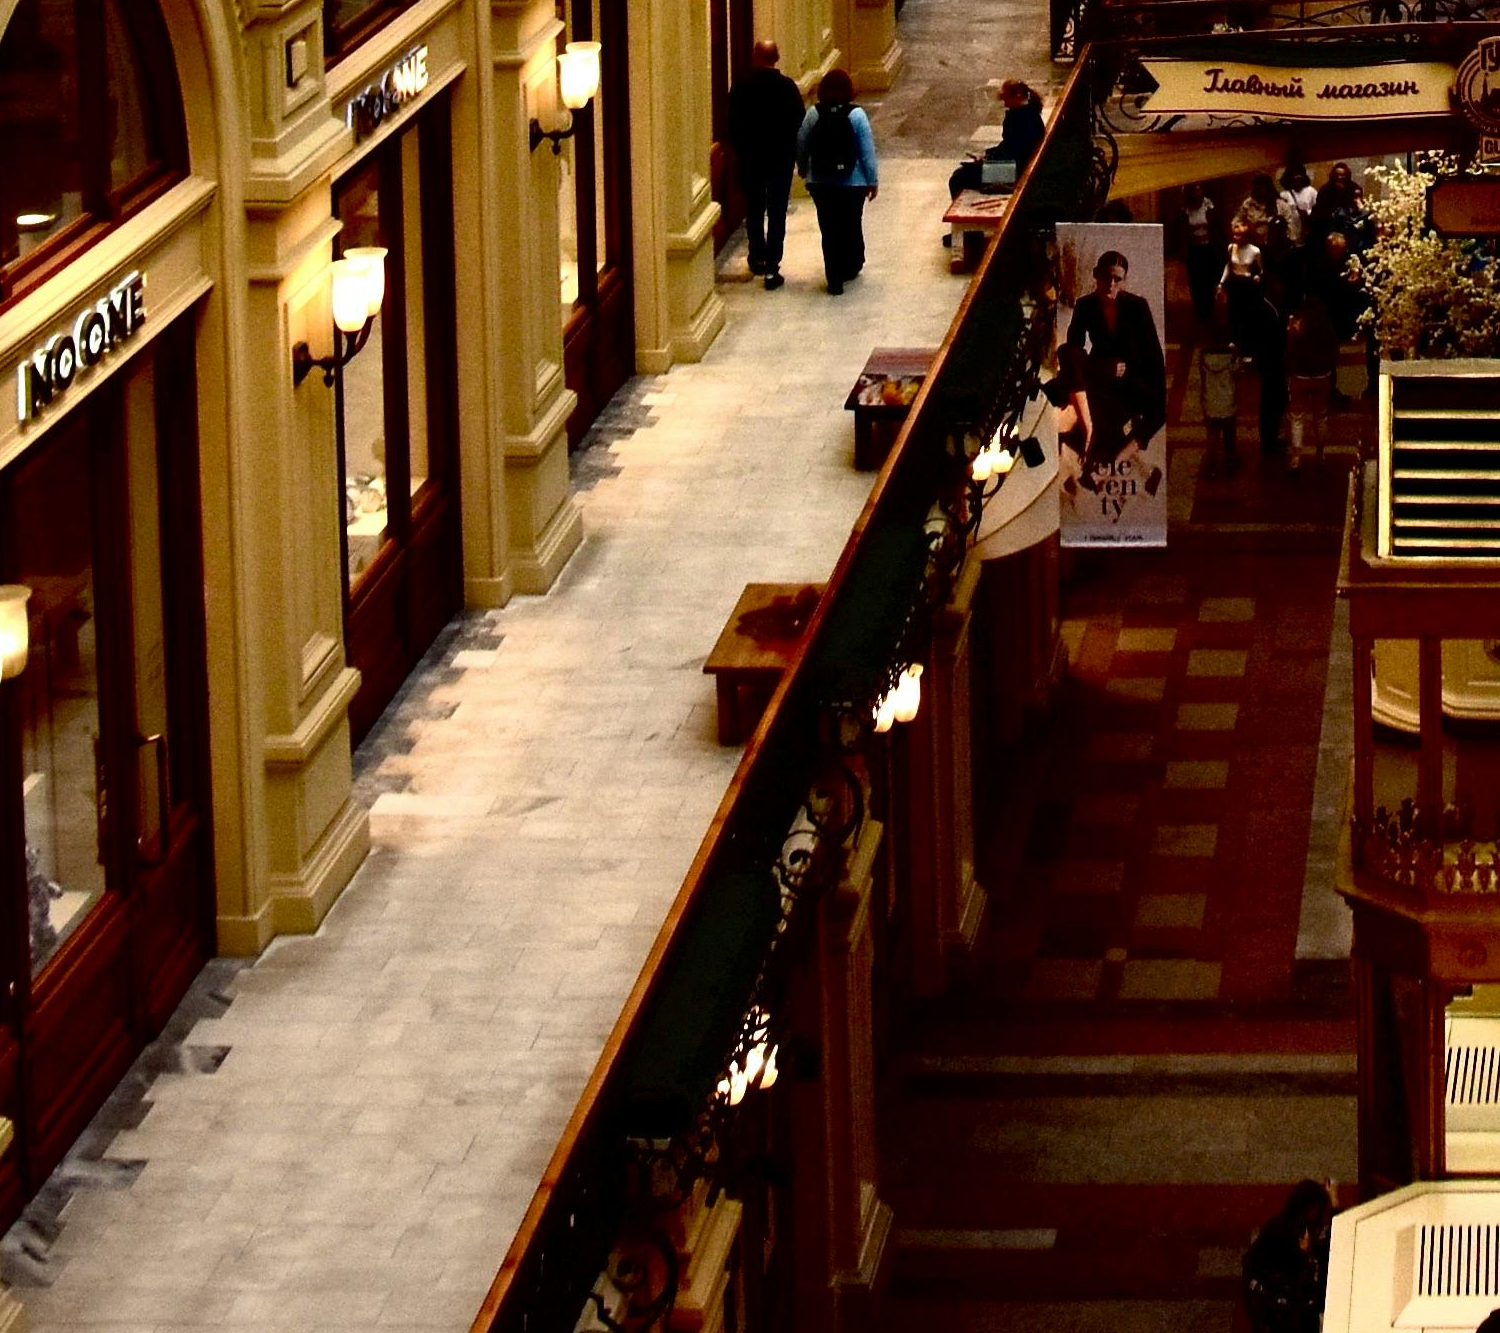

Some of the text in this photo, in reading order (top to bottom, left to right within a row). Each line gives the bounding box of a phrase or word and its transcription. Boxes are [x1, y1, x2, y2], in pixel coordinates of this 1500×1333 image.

[1203, 68, 1419, 99] Главный магазин
[17, 269, 148, 420] NO ONE
[1101, 496, 1127, 525] ty
